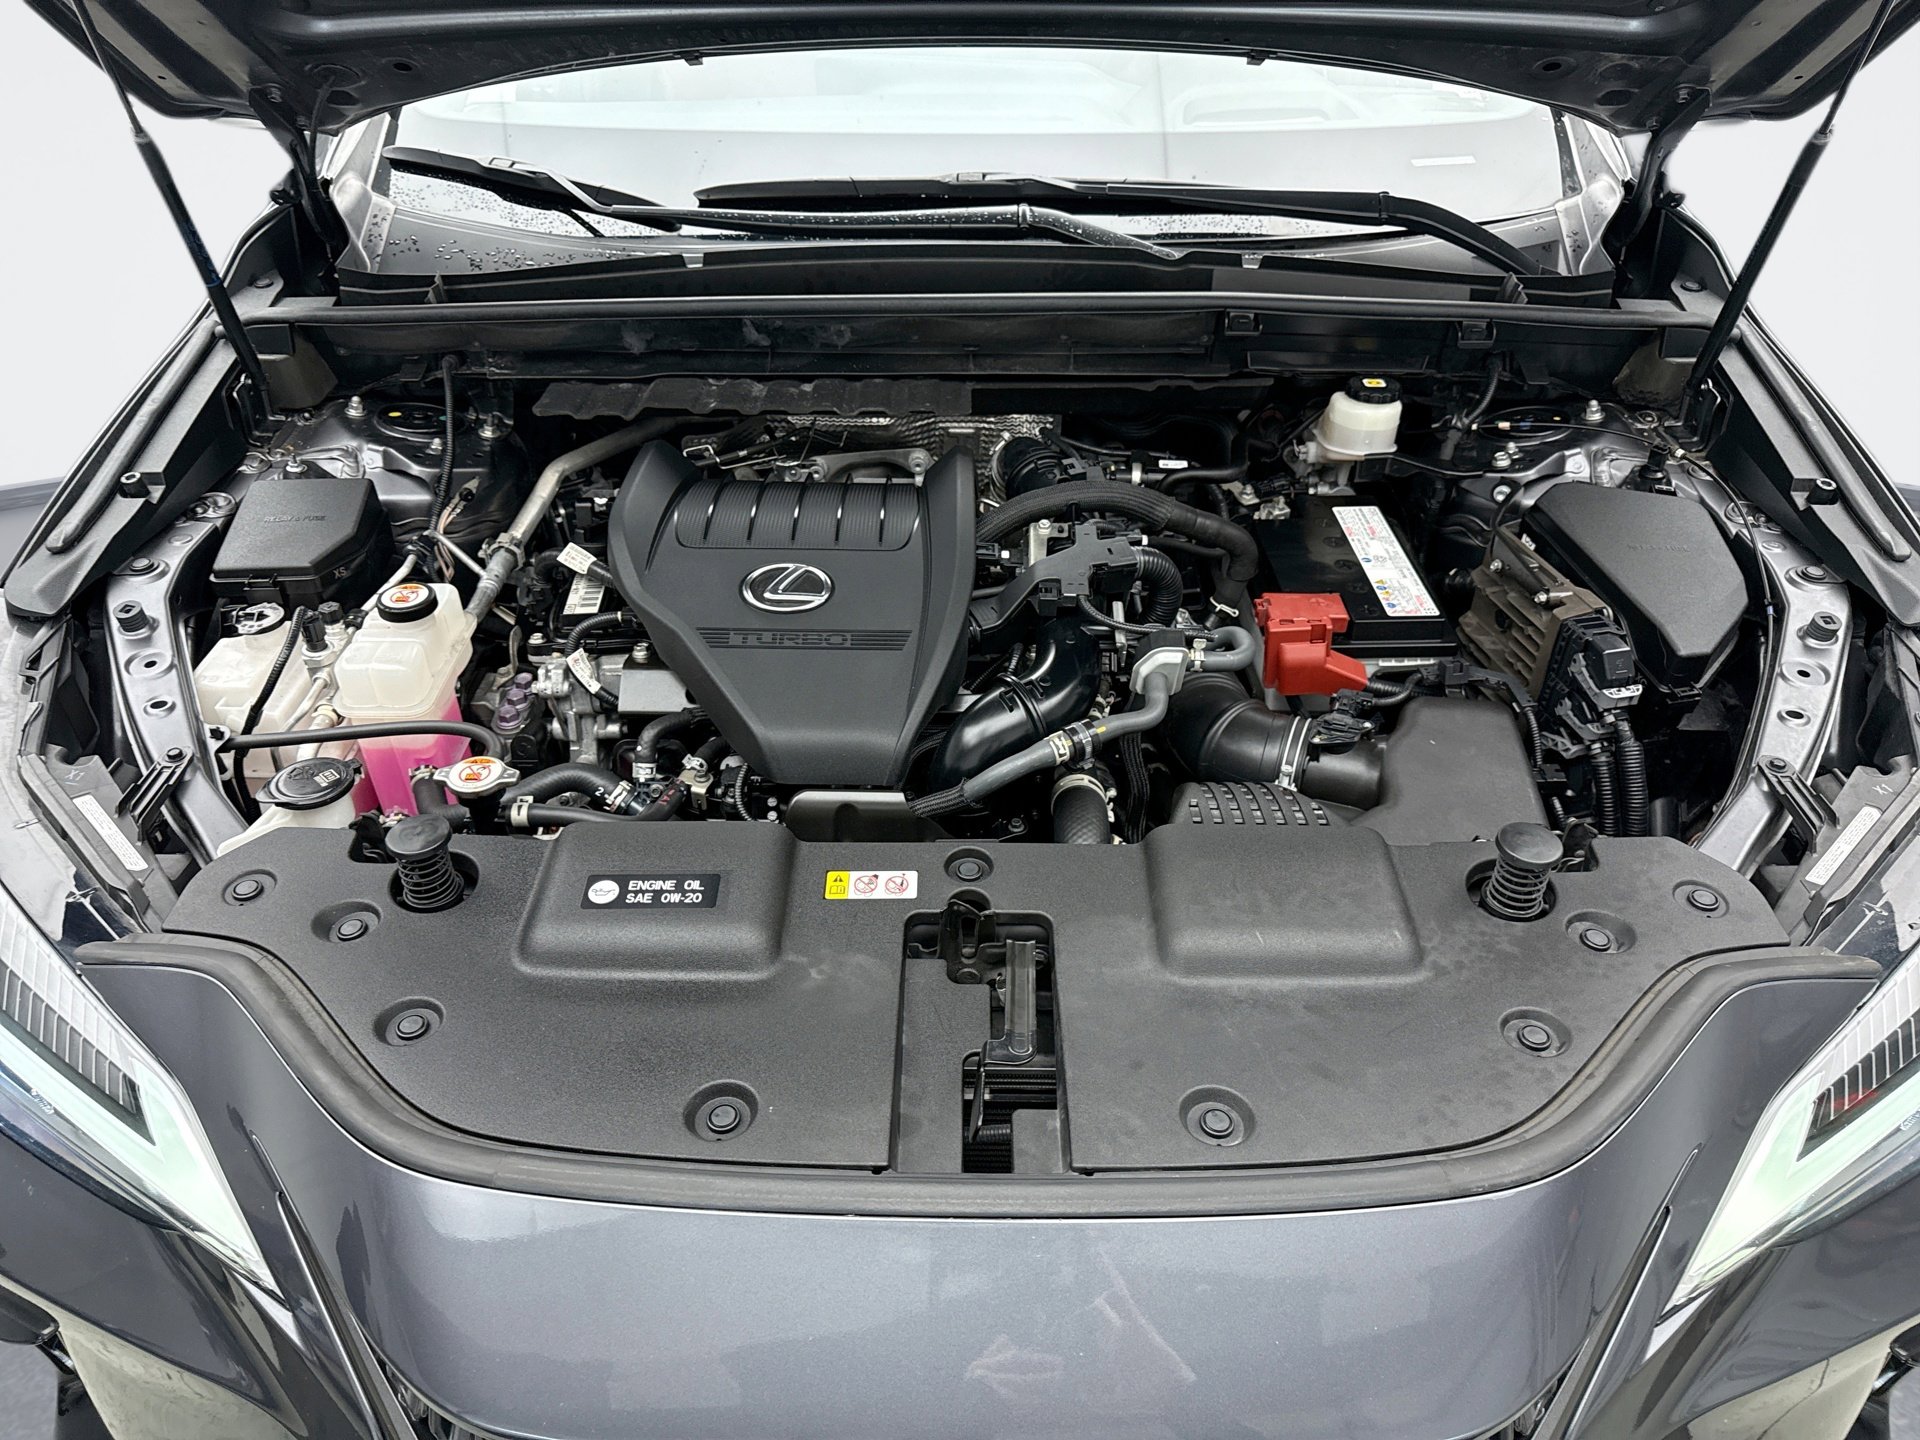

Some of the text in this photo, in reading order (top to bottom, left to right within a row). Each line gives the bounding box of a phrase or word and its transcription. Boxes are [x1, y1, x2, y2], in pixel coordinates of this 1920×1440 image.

[733, 631, 849, 646] TURBO
[628, 880, 705, 891] ENGINE OIL
[625, 893, 653, 903] SAE
